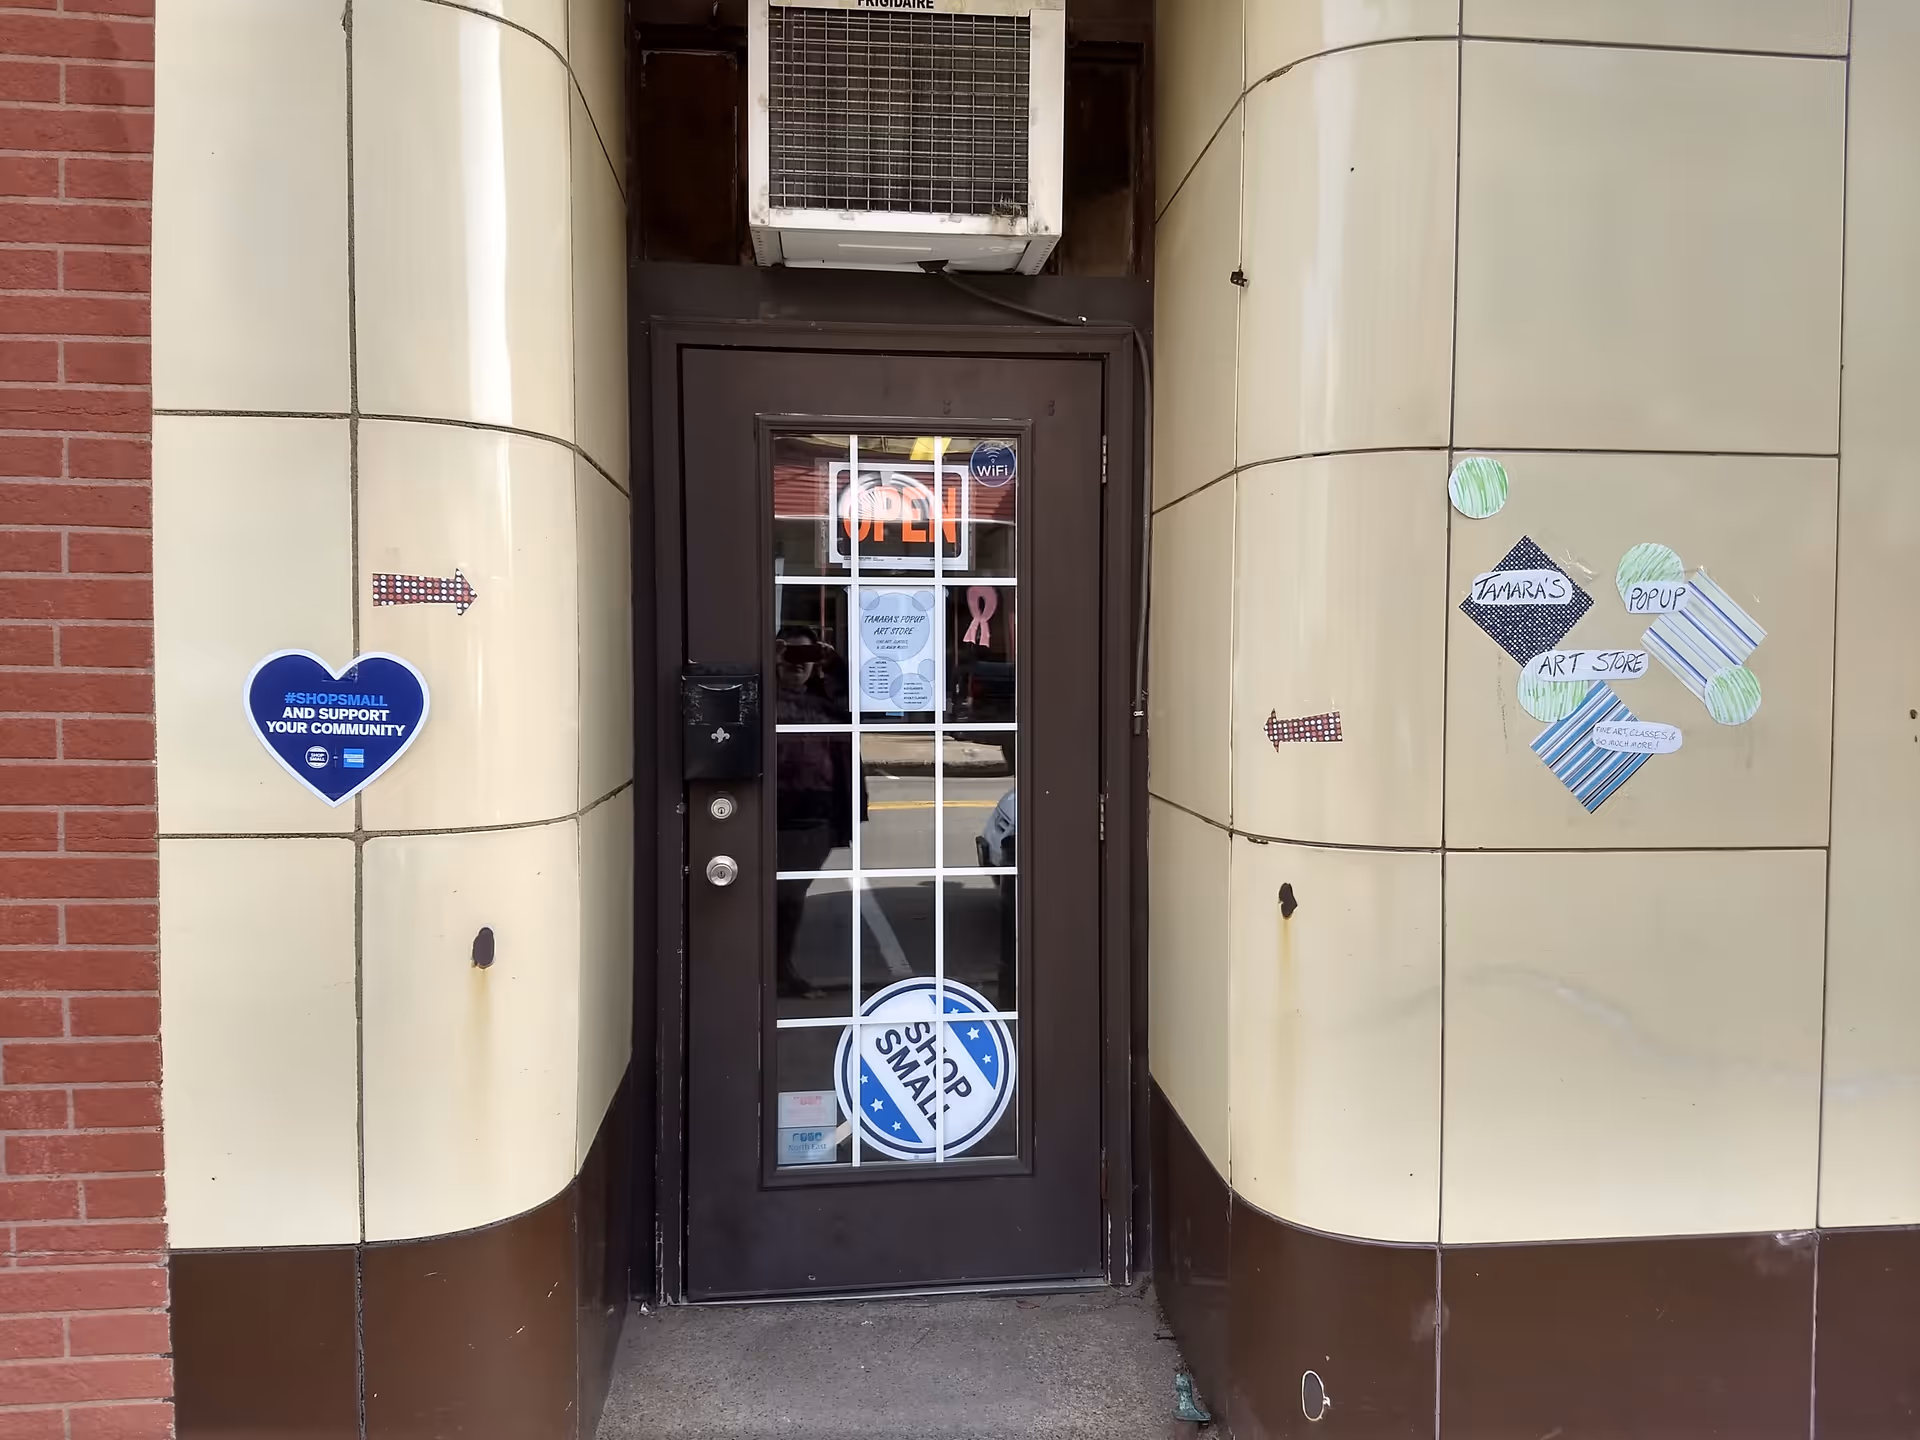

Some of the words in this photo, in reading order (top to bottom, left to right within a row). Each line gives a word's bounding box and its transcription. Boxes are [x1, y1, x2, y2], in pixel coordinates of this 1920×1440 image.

[857, 0, 934, 9] FRIGIDAIRE
[976, 464, 1008, 477] WiFi
[843, 485, 956, 543] OPEN
[1475, 573, 1566, 601] TAMARA'S
[901, 615, 926, 623] POPUP
[874, 627, 891, 635] ART
[891, 627, 915, 635] STORE
[1538, 652, 1585, 677] ART
[1592, 650, 1646, 674] STORE
[284, 692, 388, 706] #SHOPSMALL
[282, 706, 315, 719] AND
[318, 707, 390, 721] SUPPORT
[266, 720, 308, 733] YOUR
[310, 722, 406, 736] COMMUNITY
[1629, 728, 1668, 740] CLASSES
[1608, 739, 1629, 747] MUCH
[905, 1021, 972, 1098] SHOP
[875, 1029, 951, 1131] SMALL
